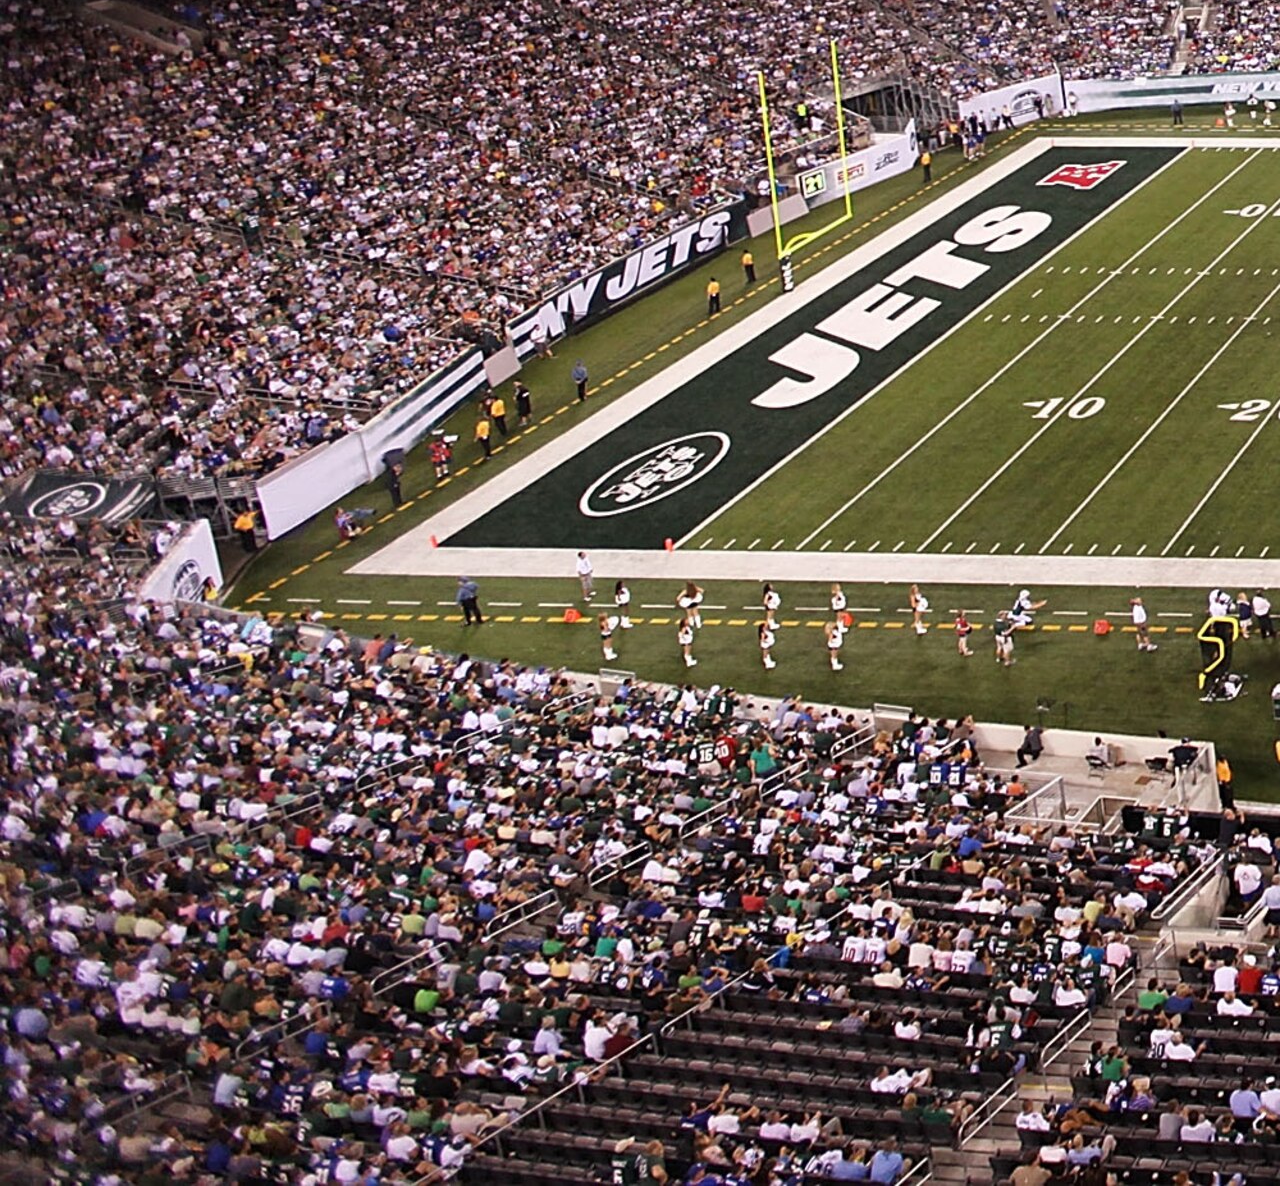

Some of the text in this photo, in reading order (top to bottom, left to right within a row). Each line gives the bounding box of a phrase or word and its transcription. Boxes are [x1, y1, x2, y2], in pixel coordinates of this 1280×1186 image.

[1211, 82, 1261, 94] NEW
[804, 172, 824, 194] 21
[537, 212, 731, 339] NY JETS
[750, 205, 1053, 409] JETS
[1033, 397, 1106, 419] 10
[700, 749, 713, 761] 16
[930, 772, 939, 784] 10
[949, 772, 959, 784] 21
[1163, 824, 1171, 836] 6
